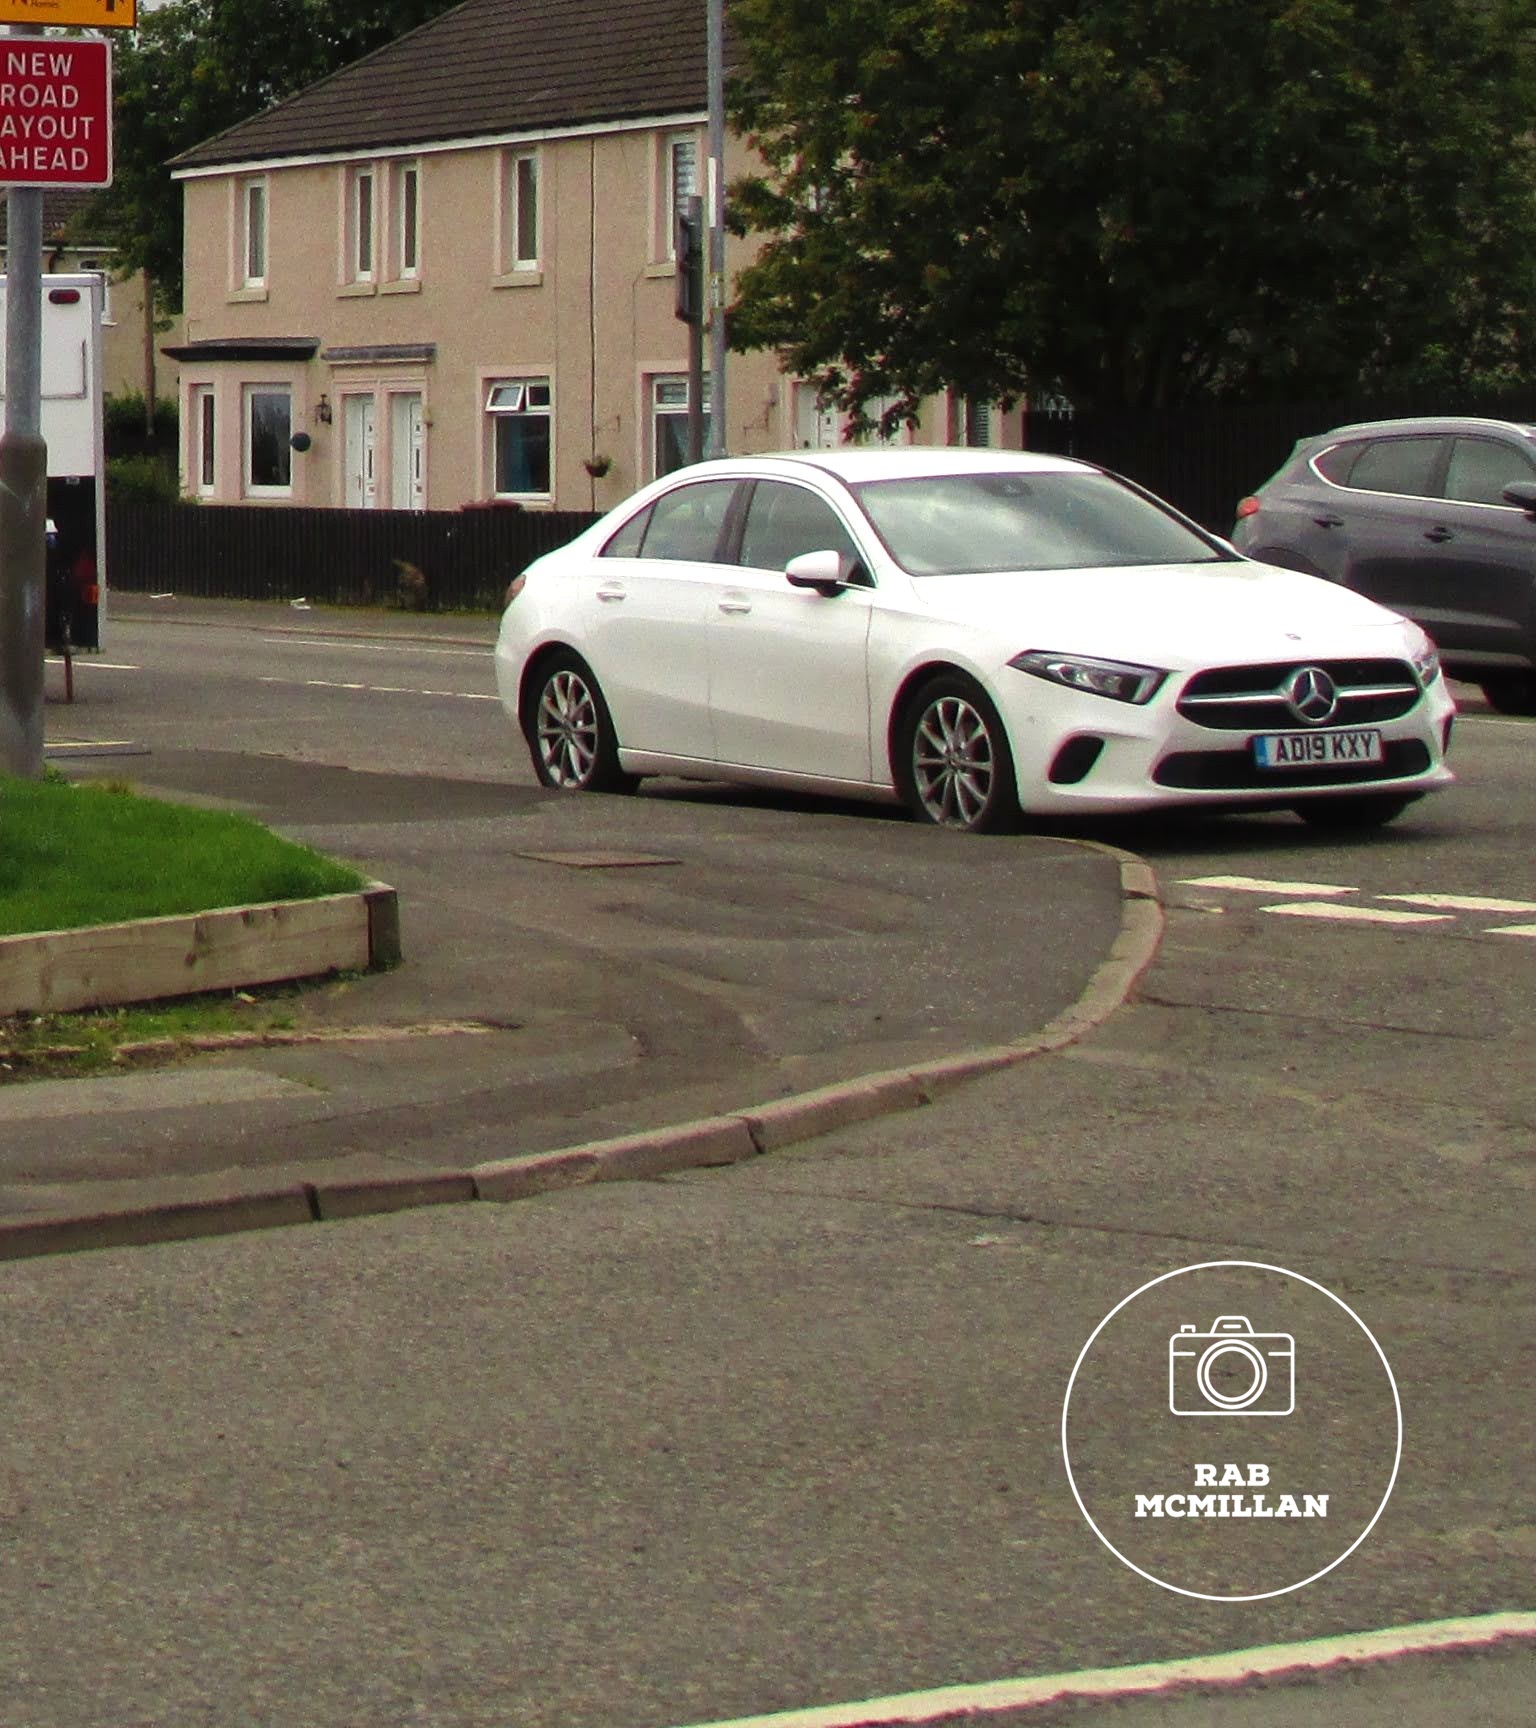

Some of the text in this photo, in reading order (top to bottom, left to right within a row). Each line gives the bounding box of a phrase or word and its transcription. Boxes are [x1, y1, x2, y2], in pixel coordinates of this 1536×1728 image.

[7, 53, 72, 76] NEW
[0, 83, 79, 109] ROAD
[1275, 733, 1372, 762] AD19 KXY
